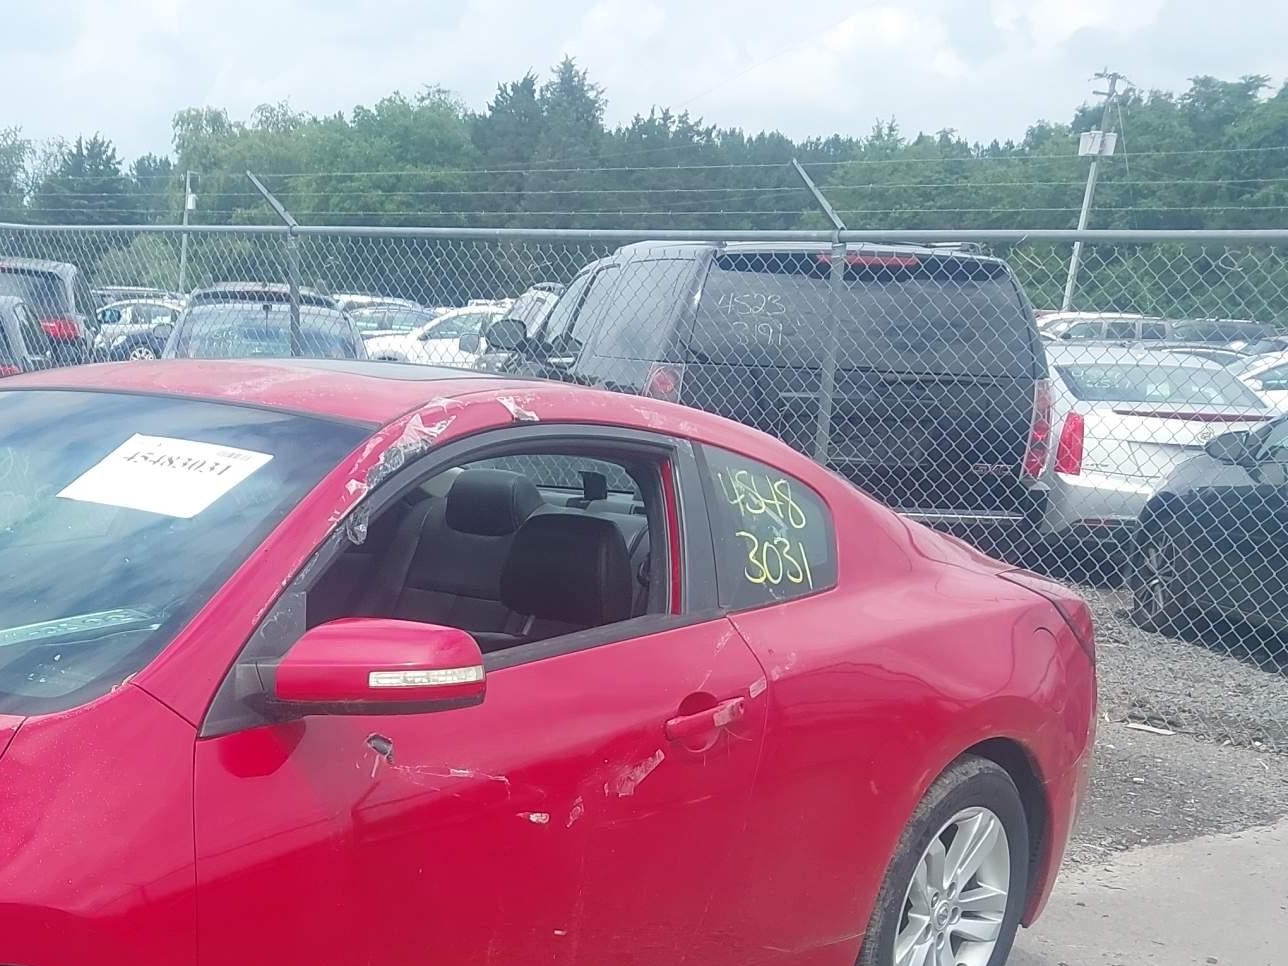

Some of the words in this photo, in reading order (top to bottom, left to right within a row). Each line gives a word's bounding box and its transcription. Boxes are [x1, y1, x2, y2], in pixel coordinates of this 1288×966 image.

[718, 293, 786, 316] 4523
[717, 467, 807, 529] 4548
[735, 531, 813, 590] 3031
